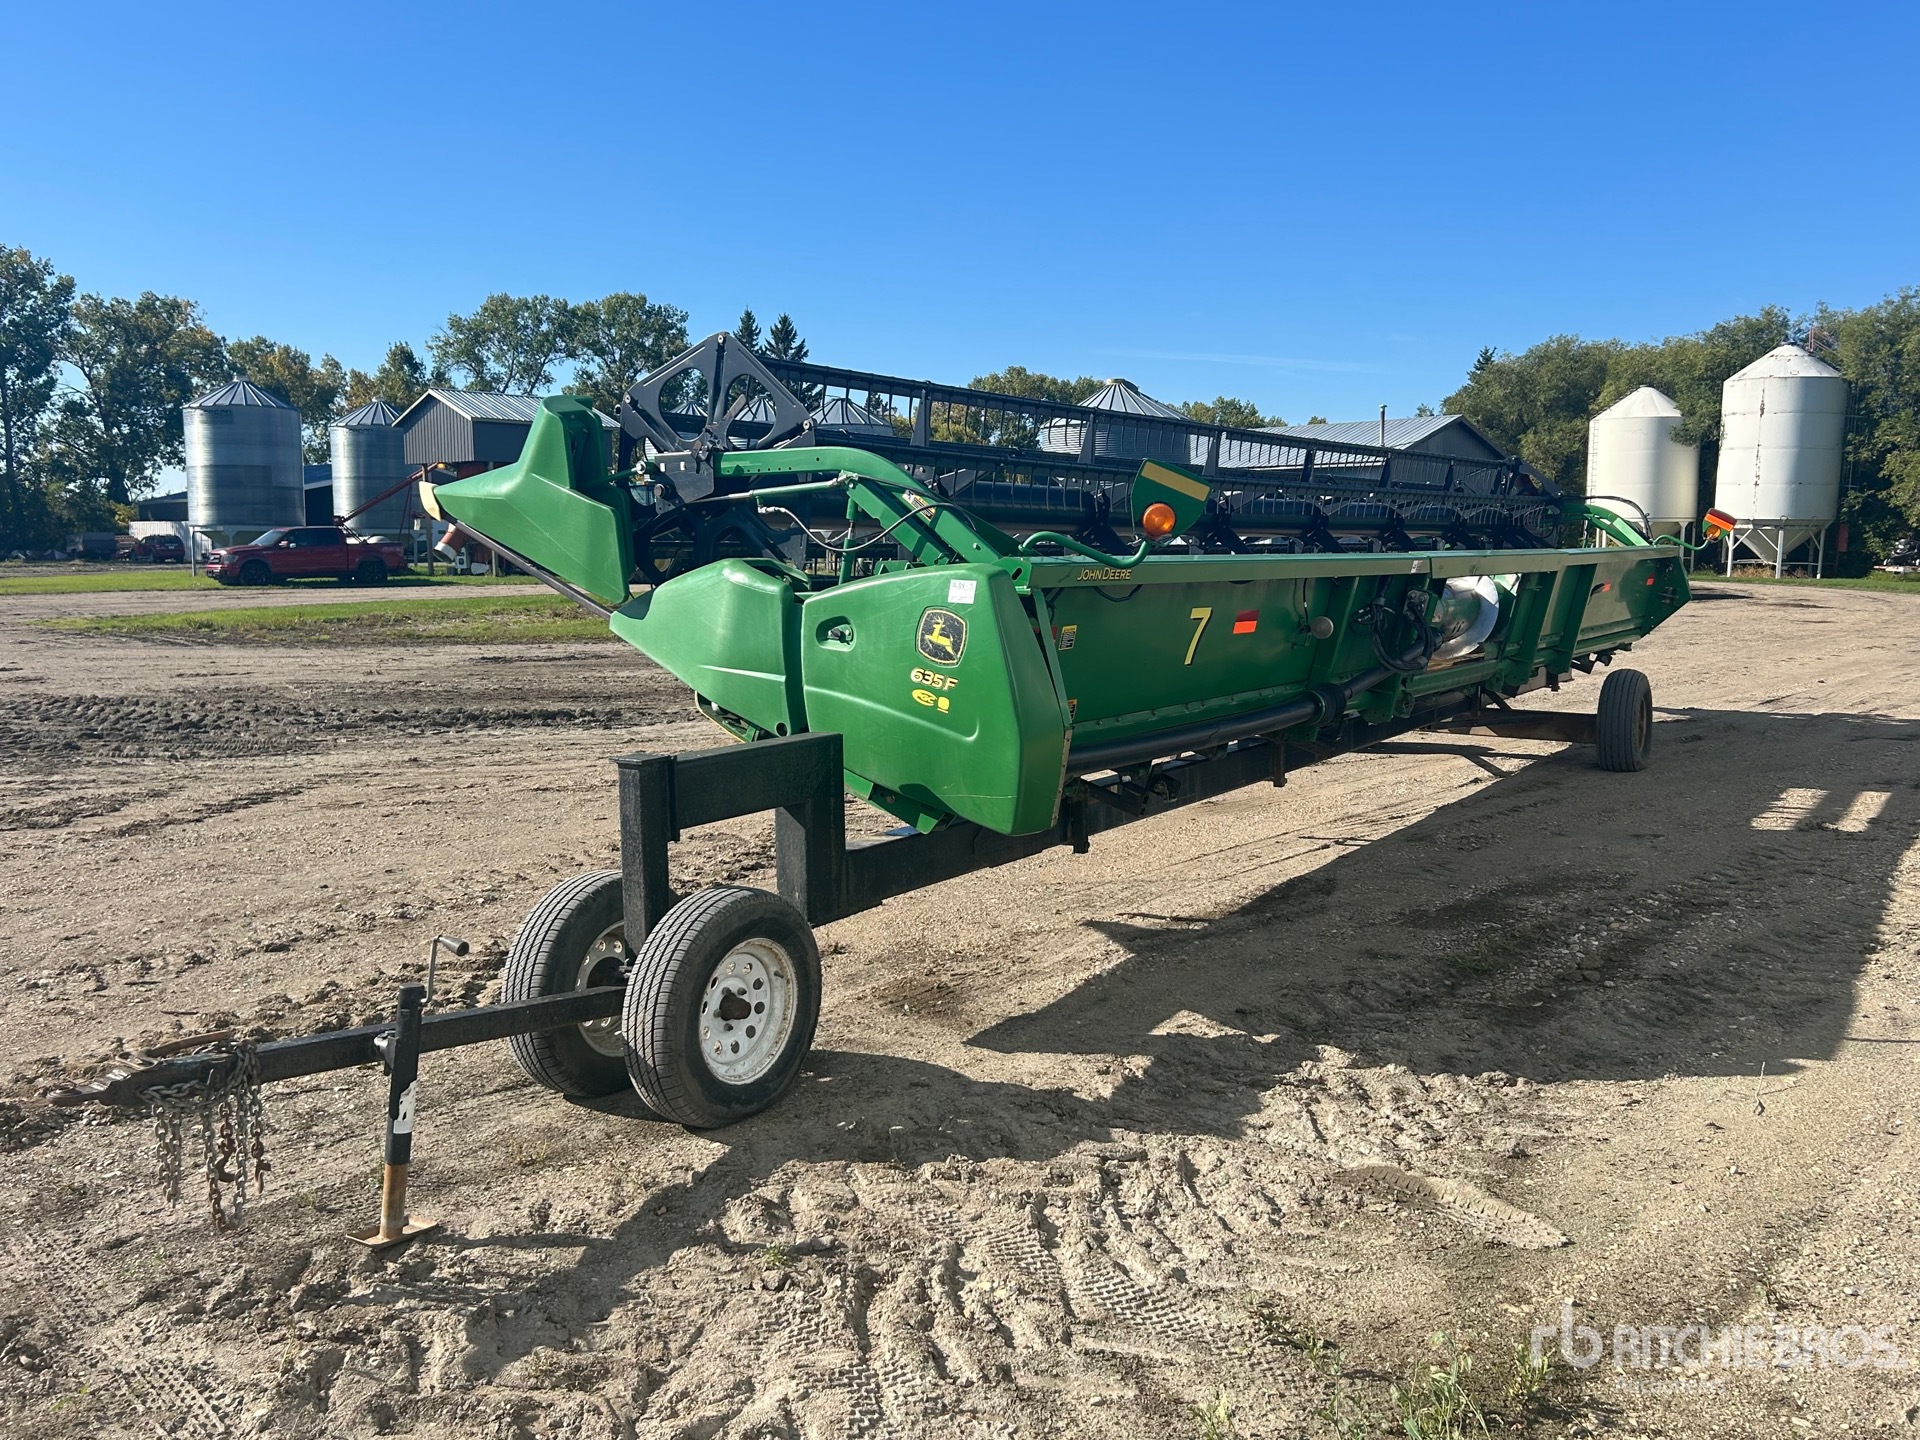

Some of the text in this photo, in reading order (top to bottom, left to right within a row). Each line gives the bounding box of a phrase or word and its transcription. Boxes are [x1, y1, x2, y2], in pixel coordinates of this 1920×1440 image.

[1076, 567, 1132, 581] JOHN DEERE
[1184, 607, 1212, 666] 7
[910, 667, 959, 691] 635F
